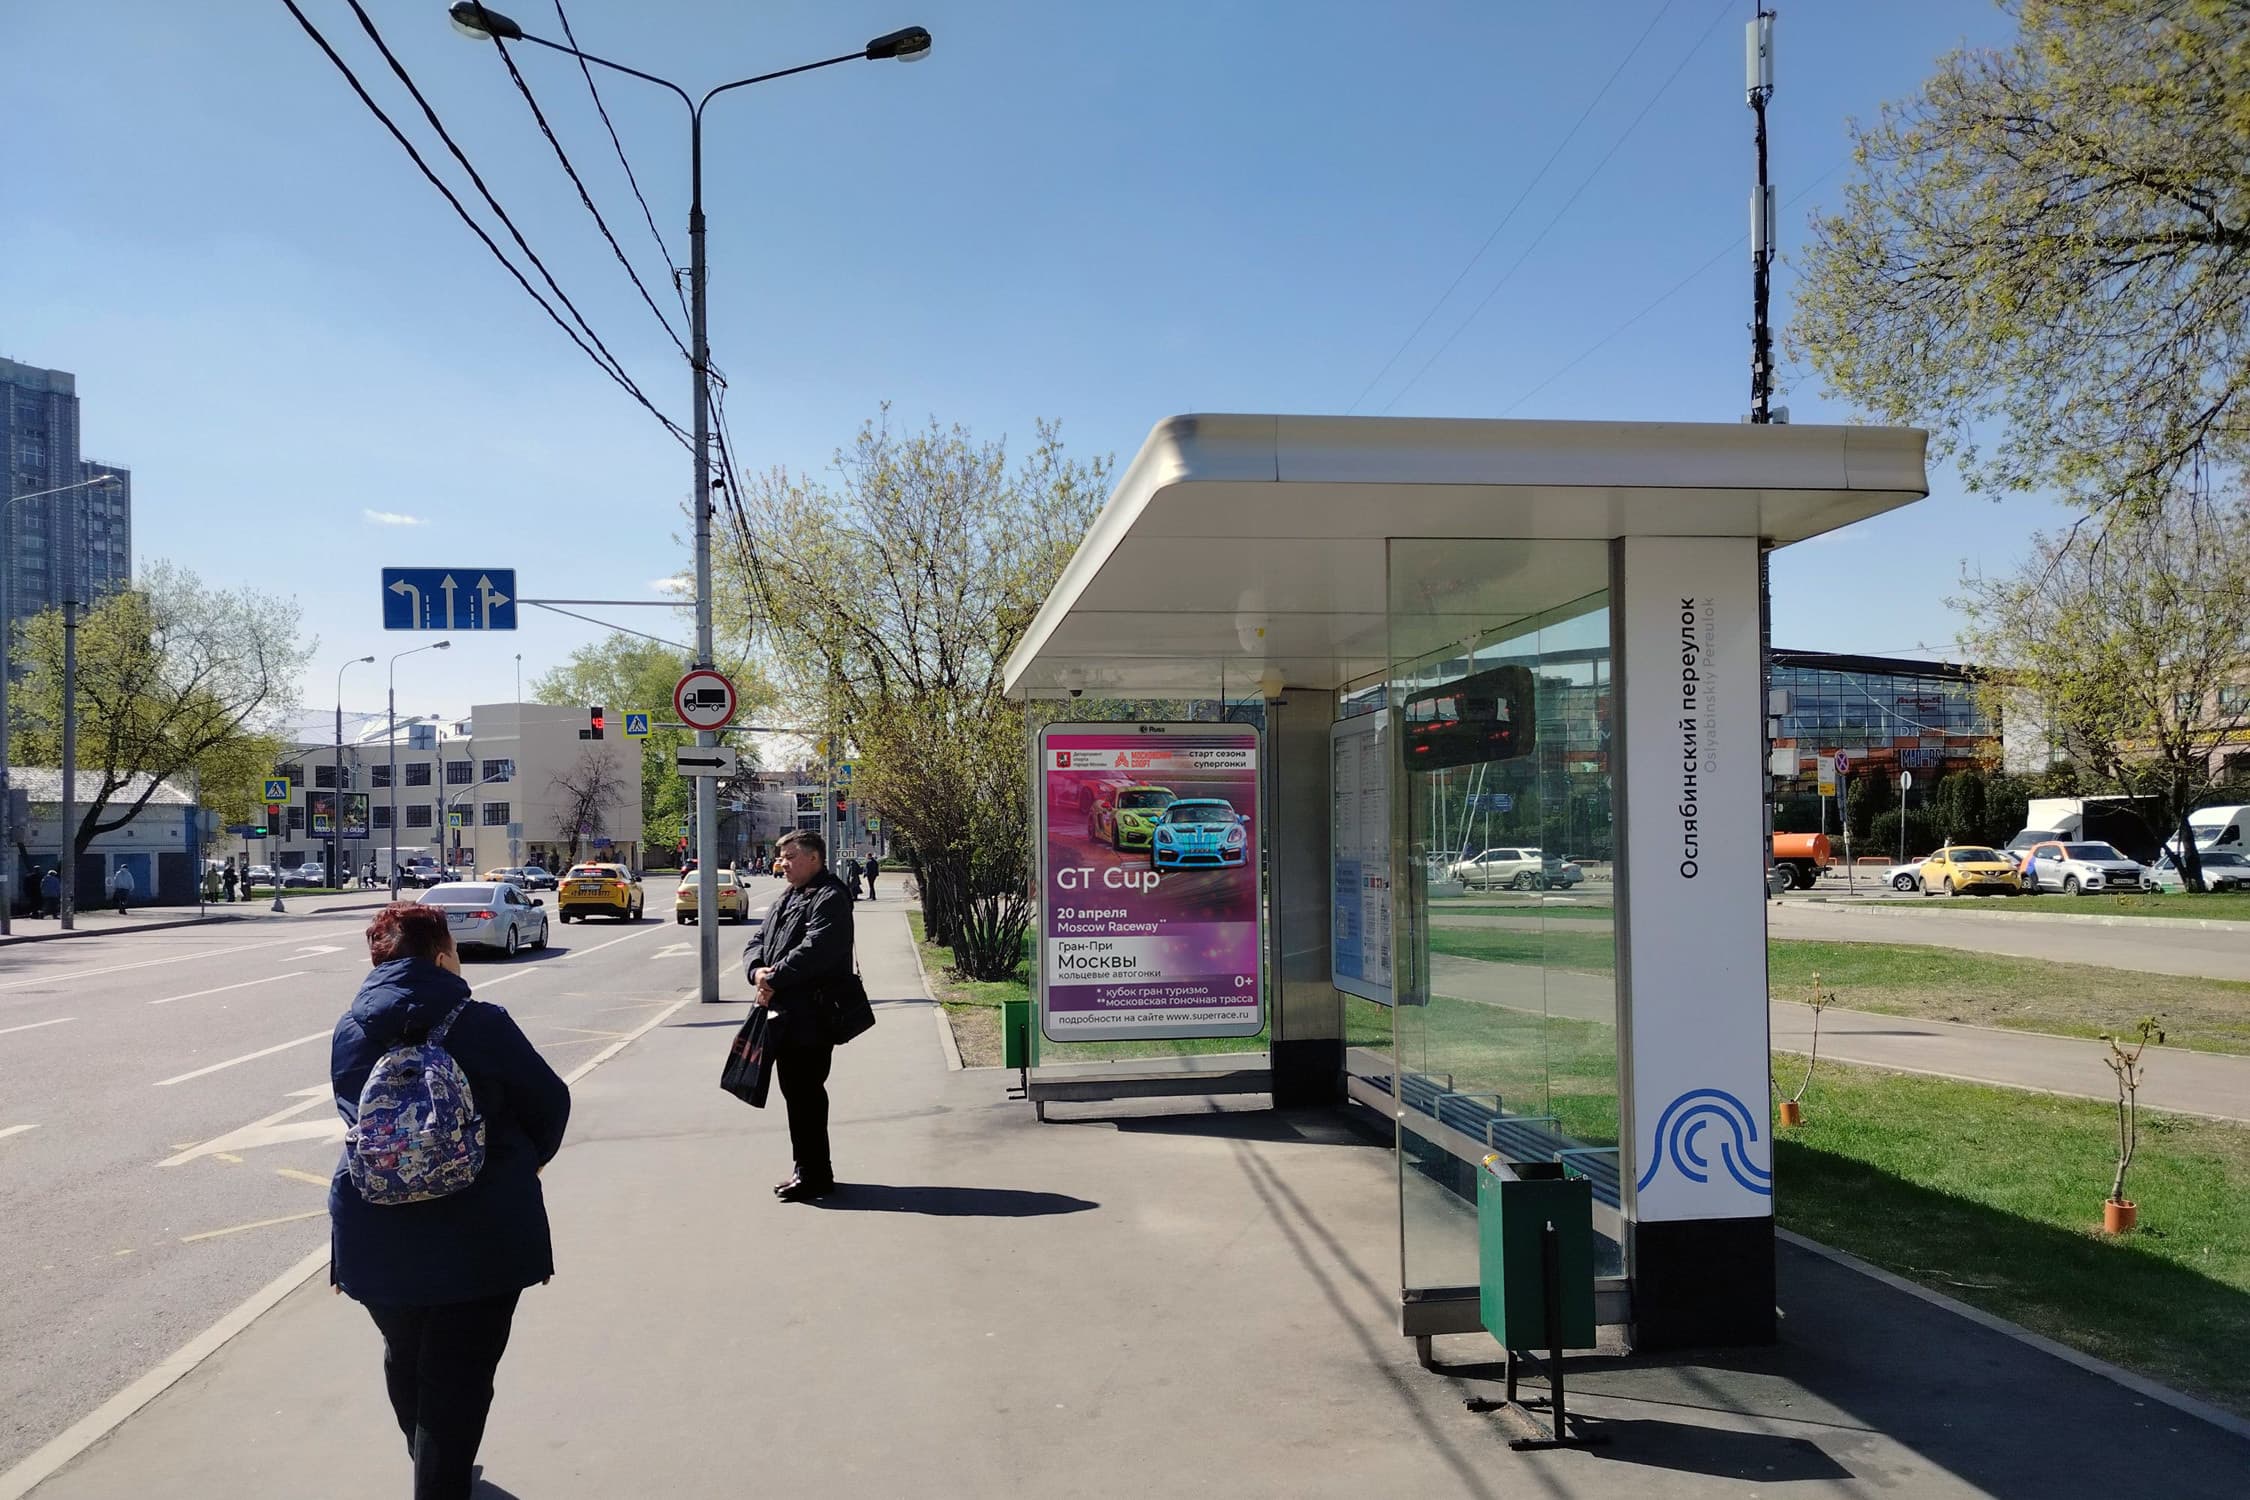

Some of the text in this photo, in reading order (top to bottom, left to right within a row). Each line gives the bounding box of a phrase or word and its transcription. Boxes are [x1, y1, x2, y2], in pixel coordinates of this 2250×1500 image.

[1702, 597, 1718, 773] Oslyabinskiy Pereulok
[1679, 598, 1700, 879] Ослябинский переулок
[1194, 760, 1246, 769] супергонки
[1057, 868, 1094, 889] GT
[1057, 909, 1127, 920] 20 апреля
[1058, 922, 1105, 932] Moscow
[1059, 941, 1113, 953] Гран-При
[1059, 954, 1136, 969] Москвы
[1059, 969, 1161, 980] кольцевые автогонки
[1234, 976, 1253, 987] 0+
[1106, 986, 1208, 997] кубок гран туризмо
[1170, 996, 1216, 1005] гоночная
[1220, 995, 1253, 1005] трасса
[1059, 1014, 1121, 1024] подробности
[1137, 1012, 1164, 1022] сайте
[1166, 1011, 1248, 1022] www.superrace.ru
